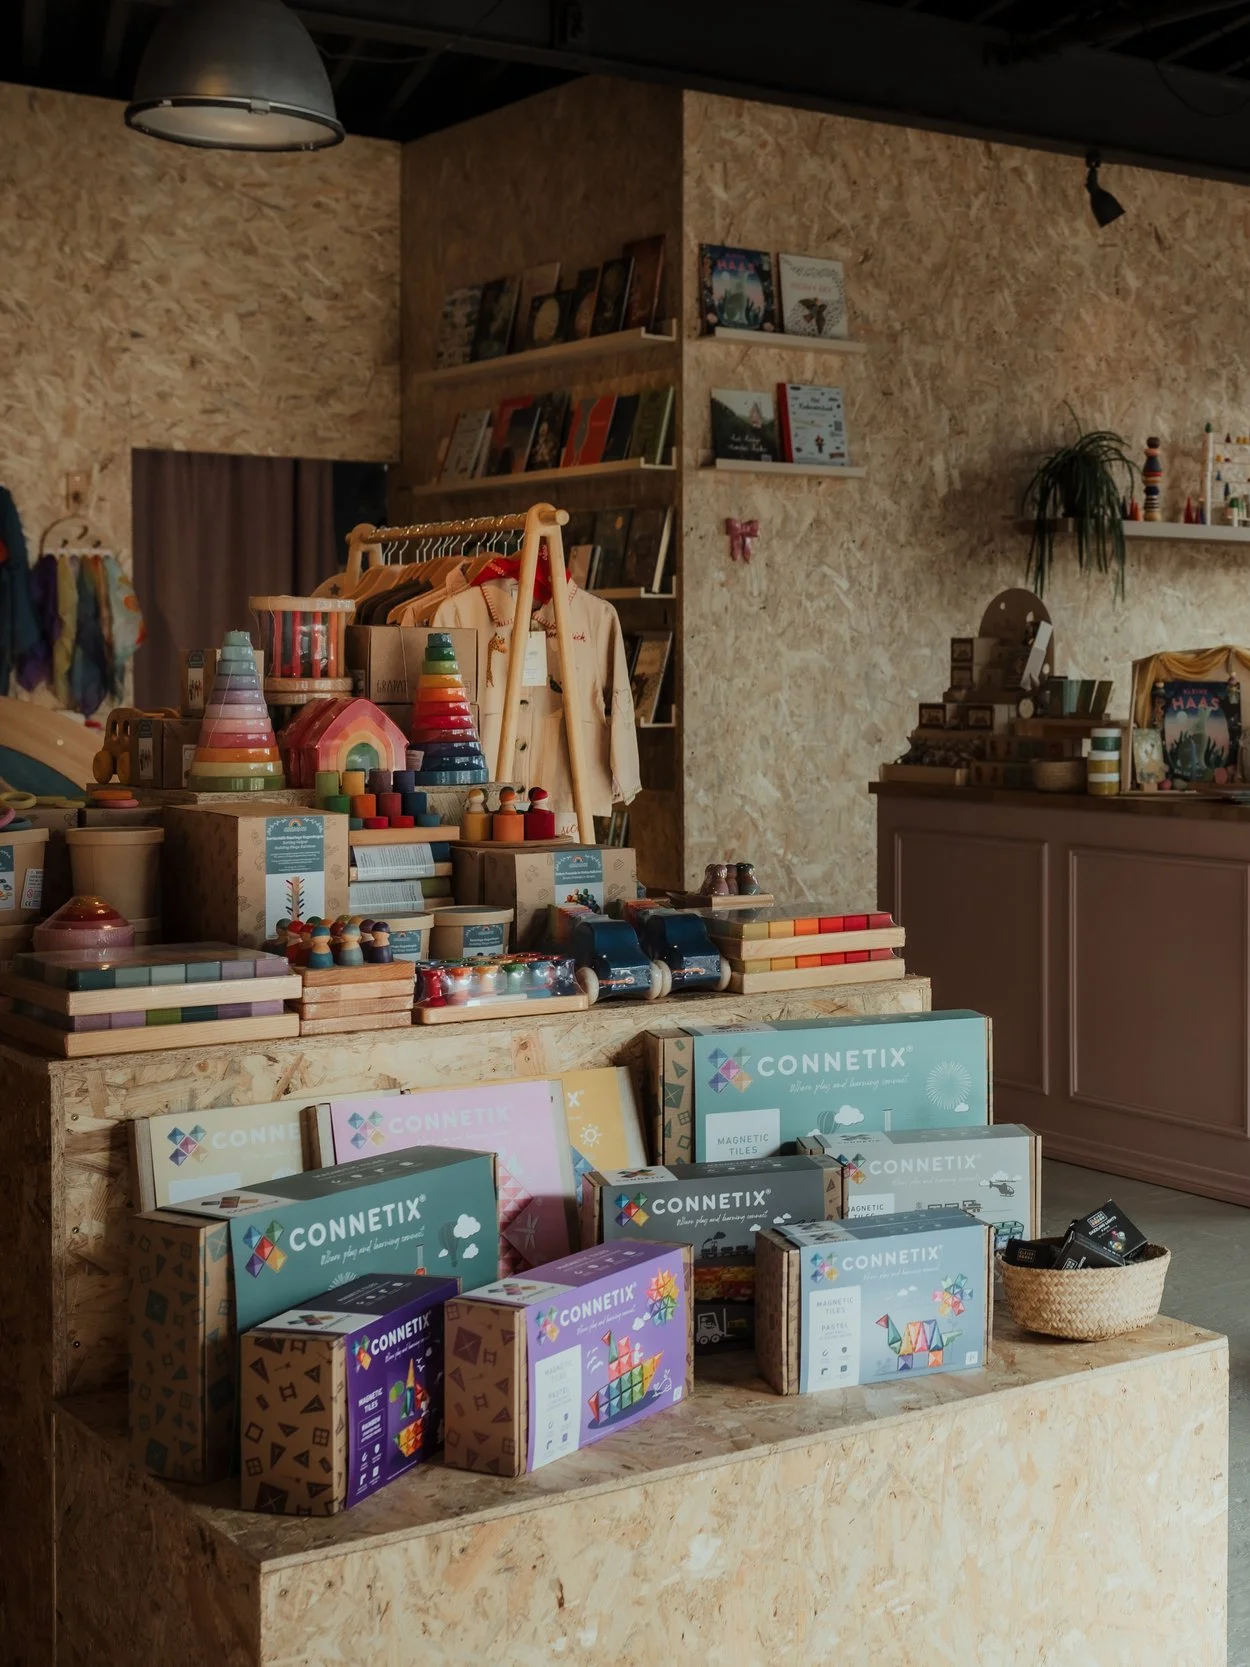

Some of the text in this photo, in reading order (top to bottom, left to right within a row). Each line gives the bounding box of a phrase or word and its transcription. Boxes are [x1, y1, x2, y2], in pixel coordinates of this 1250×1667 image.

[1171, 695, 1220, 711] HAAS
[211, 1122, 299, 1149] CONNE
[717, 1133, 769, 1145] MAGNETIC
[729, 1146, 758, 1156] TILES
[816, 1296, 854, 1308] MAGNETIC
[826, 1306, 846, 1315] TILES
[364, 1400, 378, 1413] TILES
